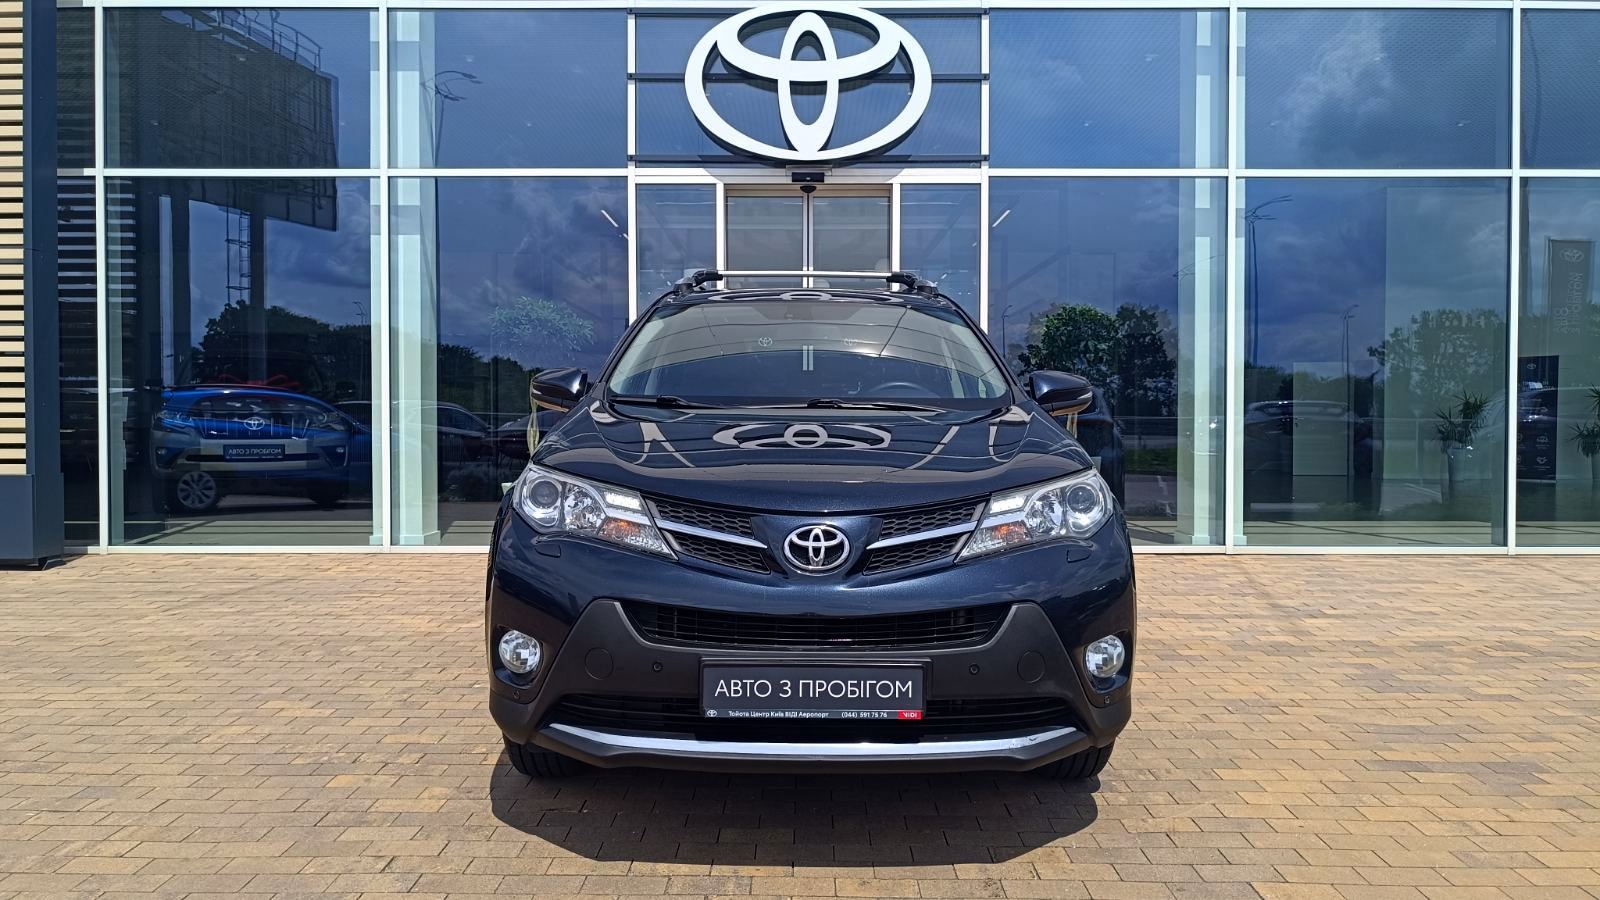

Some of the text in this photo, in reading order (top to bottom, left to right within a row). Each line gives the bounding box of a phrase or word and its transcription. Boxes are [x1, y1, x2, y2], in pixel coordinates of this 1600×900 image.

[714, 679, 912, 698] АВТО З ПРОБІГОМ
[799, 711, 829, 719] Аеропорт
[841, 711, 858, 719] (044)
